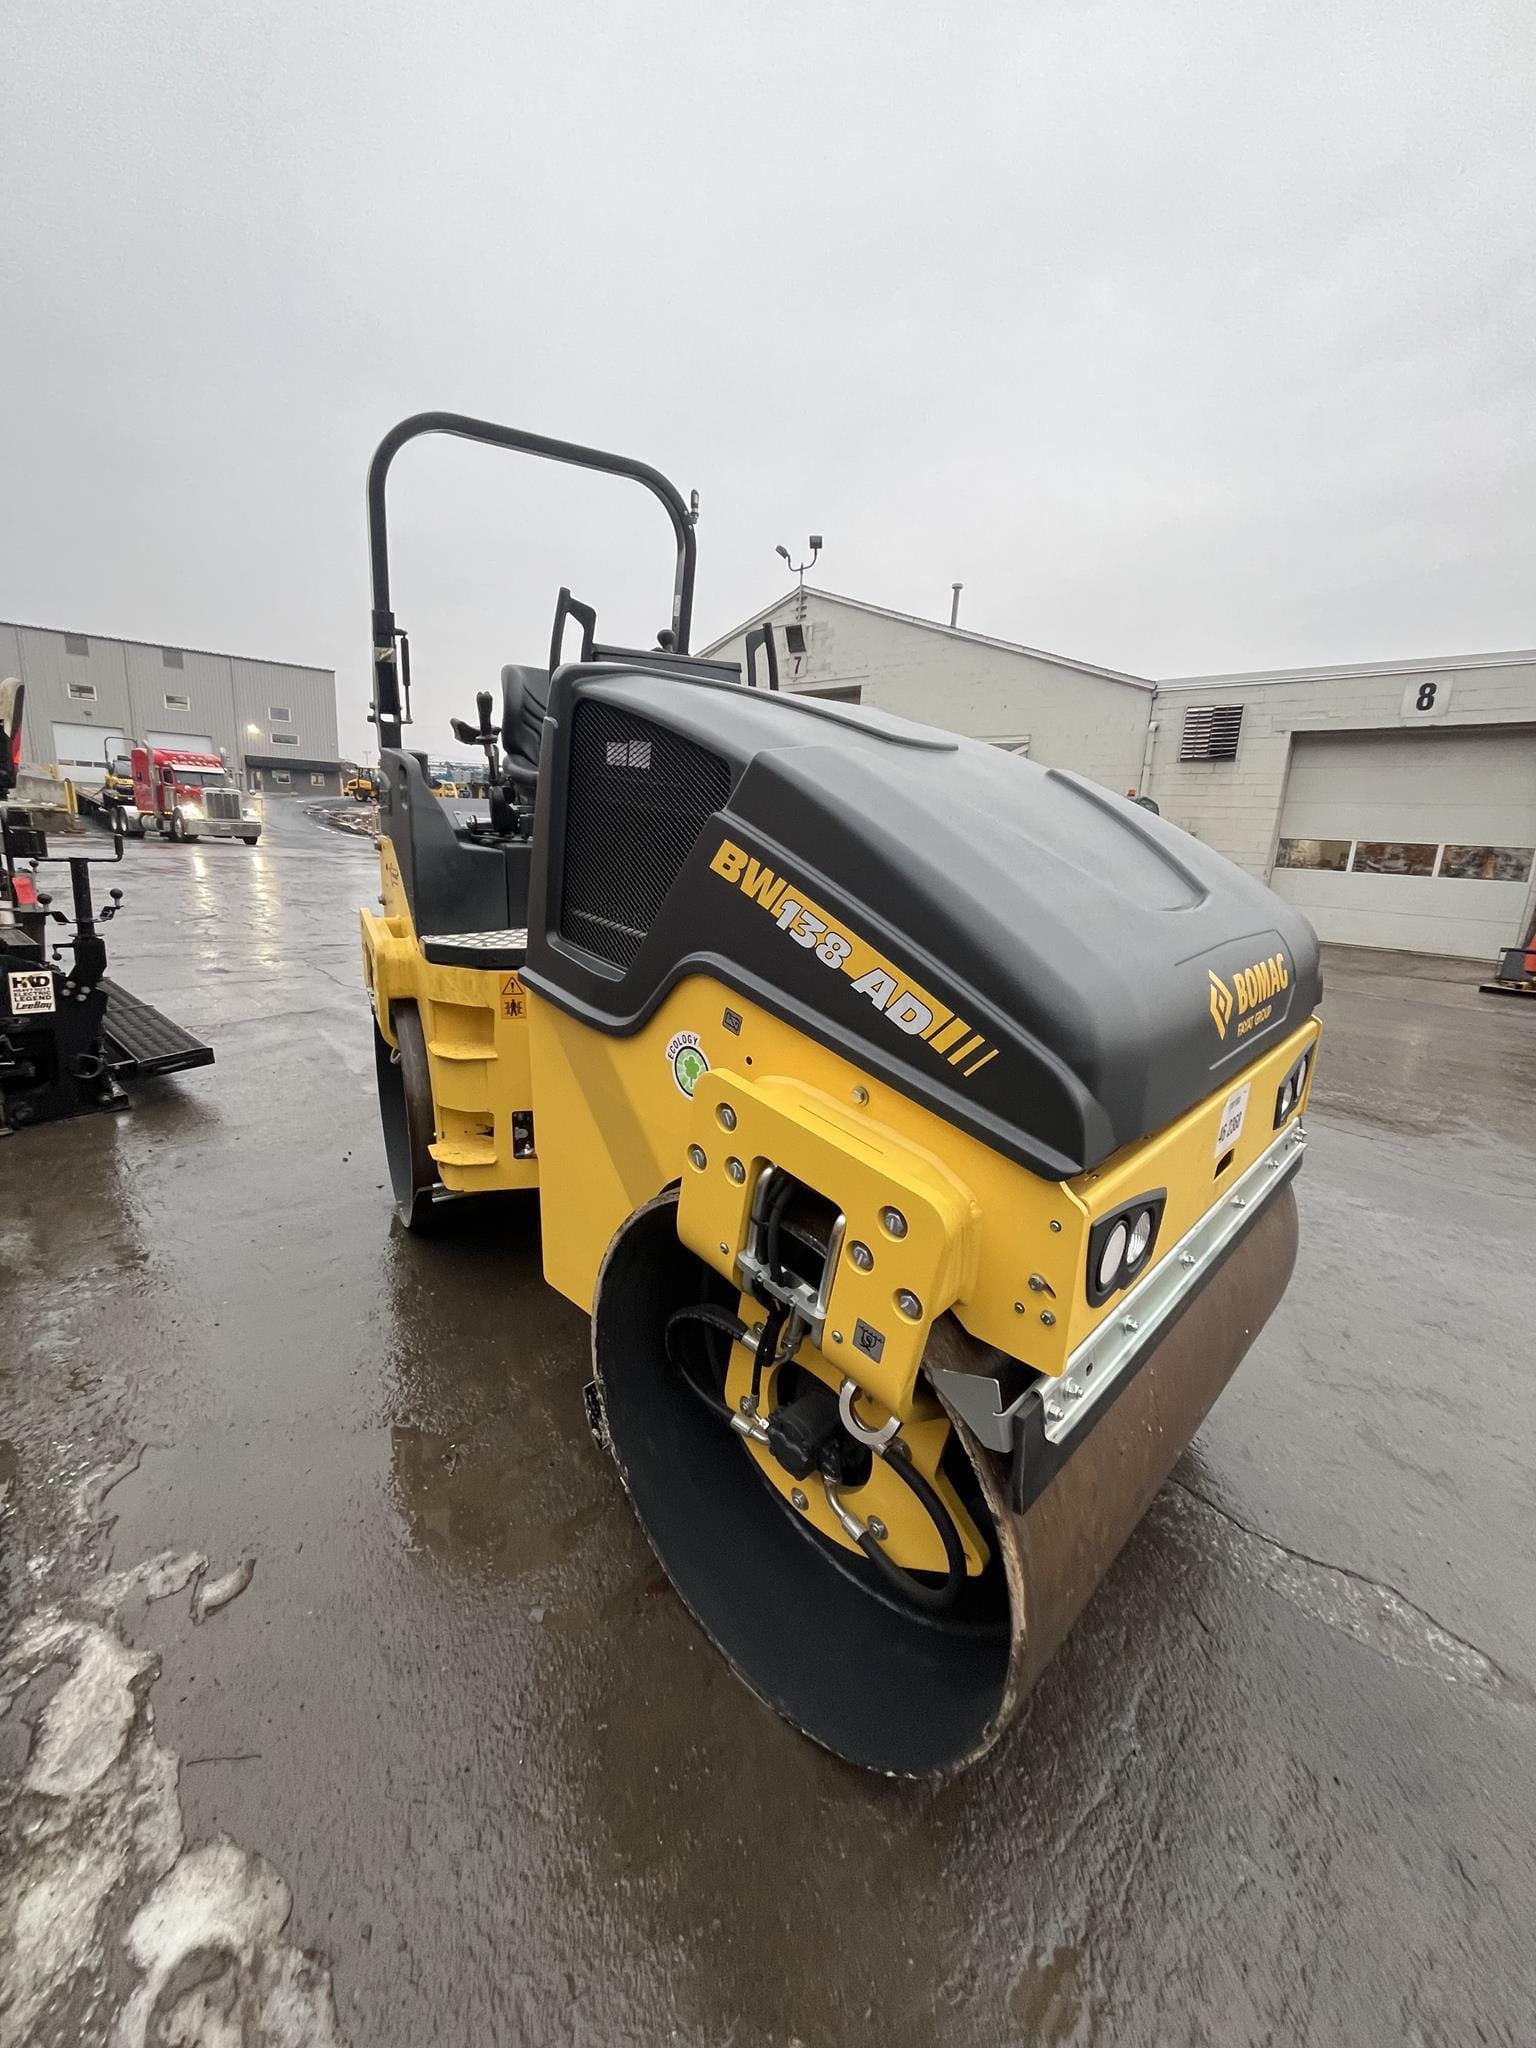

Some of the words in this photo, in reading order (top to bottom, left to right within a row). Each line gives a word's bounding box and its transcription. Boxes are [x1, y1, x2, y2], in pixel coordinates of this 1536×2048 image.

[794, 656, 801, 674] 7
[1416, 683, 1437, 711] 8
[850, 967, 934, 1035] AD
[667, 1034, 698, 1060] ECOLOGY
